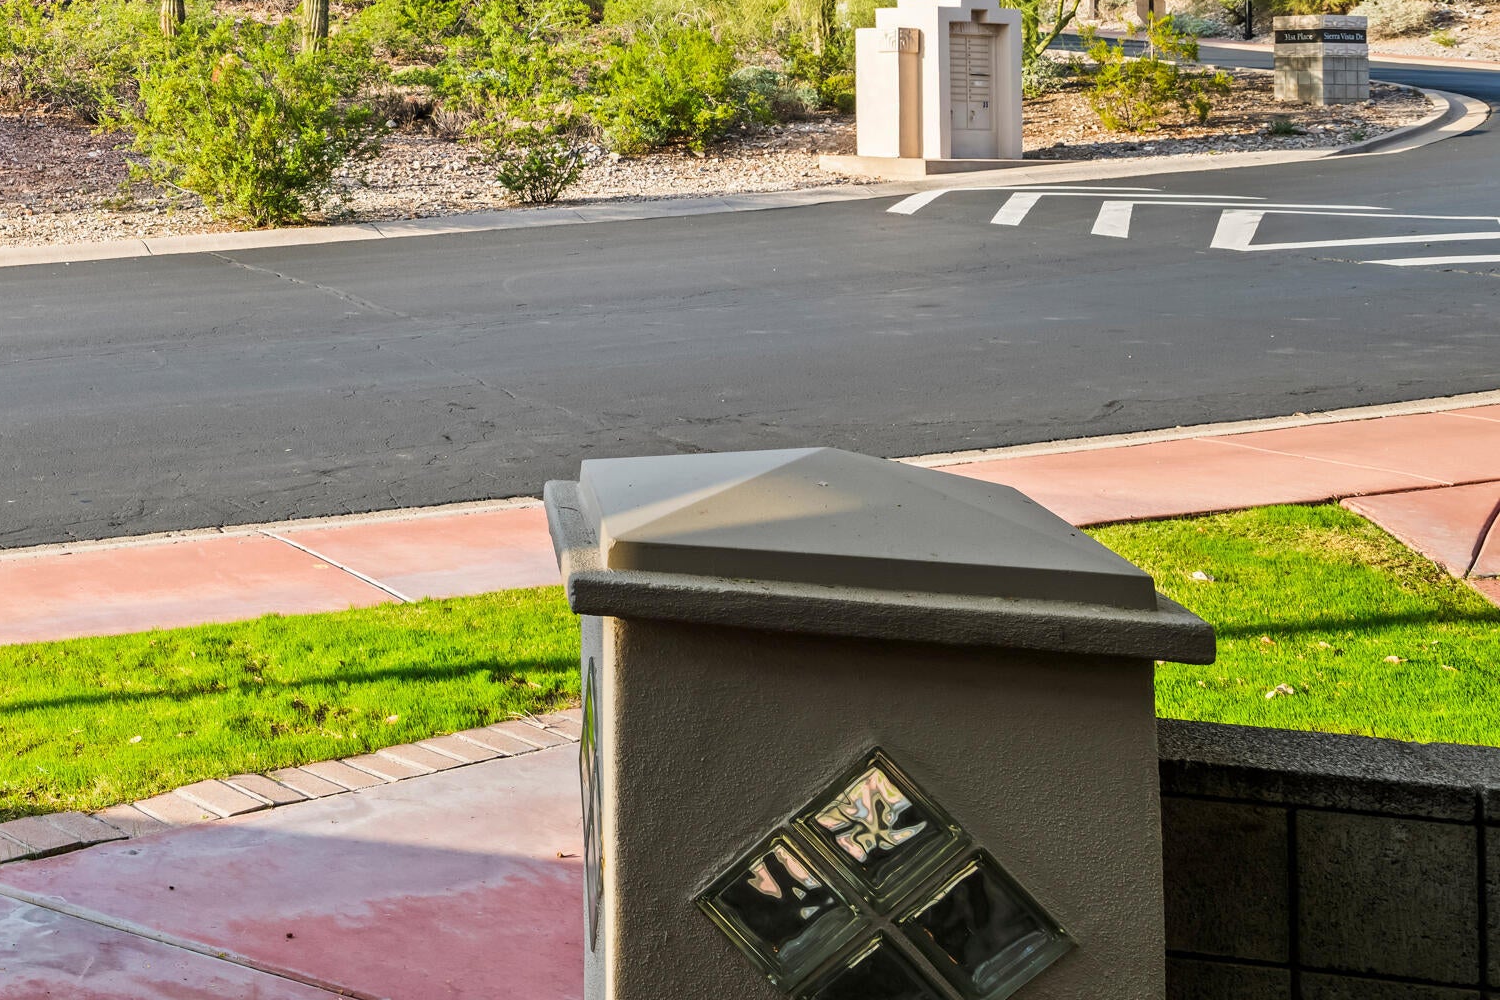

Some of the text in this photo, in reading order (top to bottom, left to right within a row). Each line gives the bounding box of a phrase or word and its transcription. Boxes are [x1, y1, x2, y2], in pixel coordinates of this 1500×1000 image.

[1297, 32, 1313, 40] Place
[1323, 32, 1340, 40] Sierra
[1341, 32, 1354, 40] Vista
